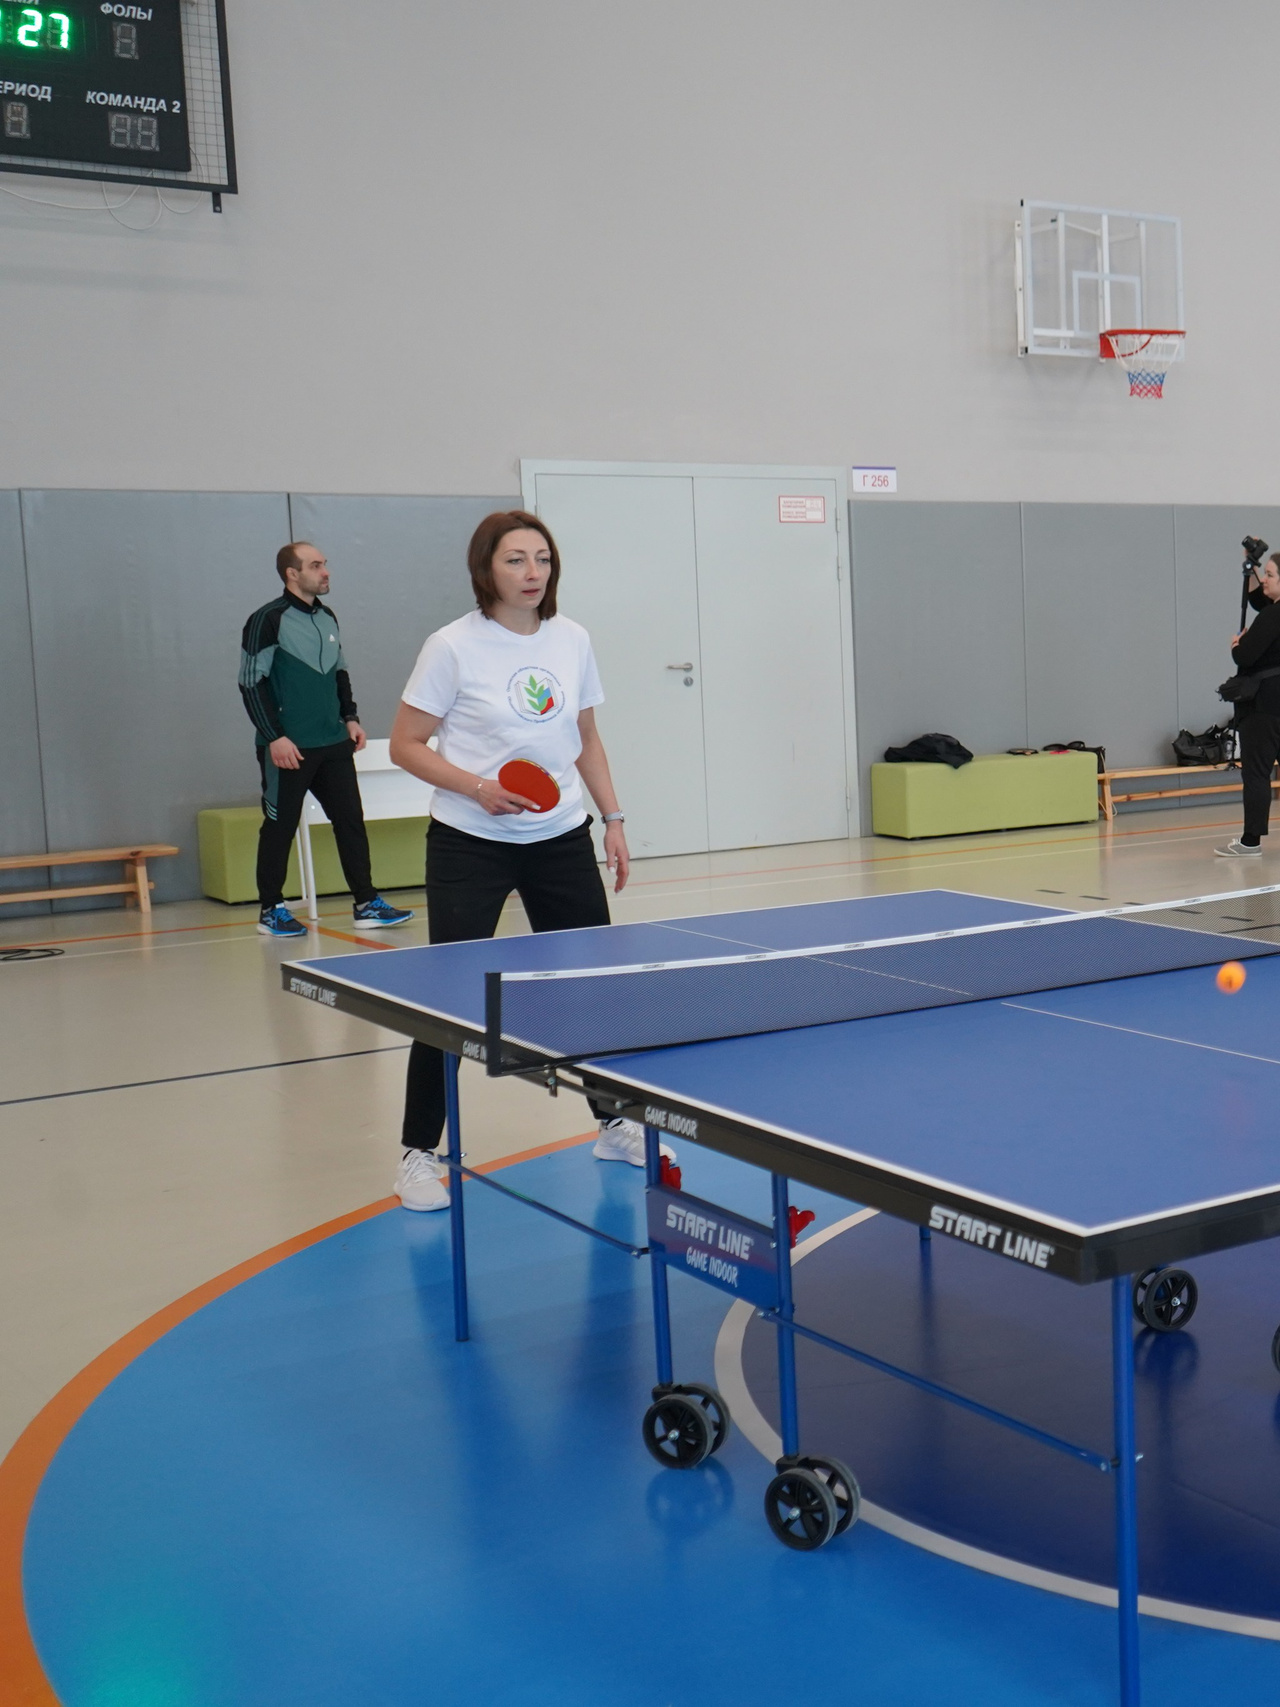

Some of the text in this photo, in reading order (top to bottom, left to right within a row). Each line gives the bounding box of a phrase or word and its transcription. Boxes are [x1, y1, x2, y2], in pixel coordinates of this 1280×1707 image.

[101, 2, 152, 21] ФОЛЫ
[86, 90, 181, 113] КОМАНДА 2
[871, 475, 889, 487] 256
[289, 977, 338, 1007] START LINE
[462, 1040, 480, 1059] GAME
[644, 1106, 698, 1139] GAME INDOOR
[666, 1204, 717, 1245] START
[928, 1205, 1002, 1249] START
[686, 1246, 738, 1288] GAME INDOOR
